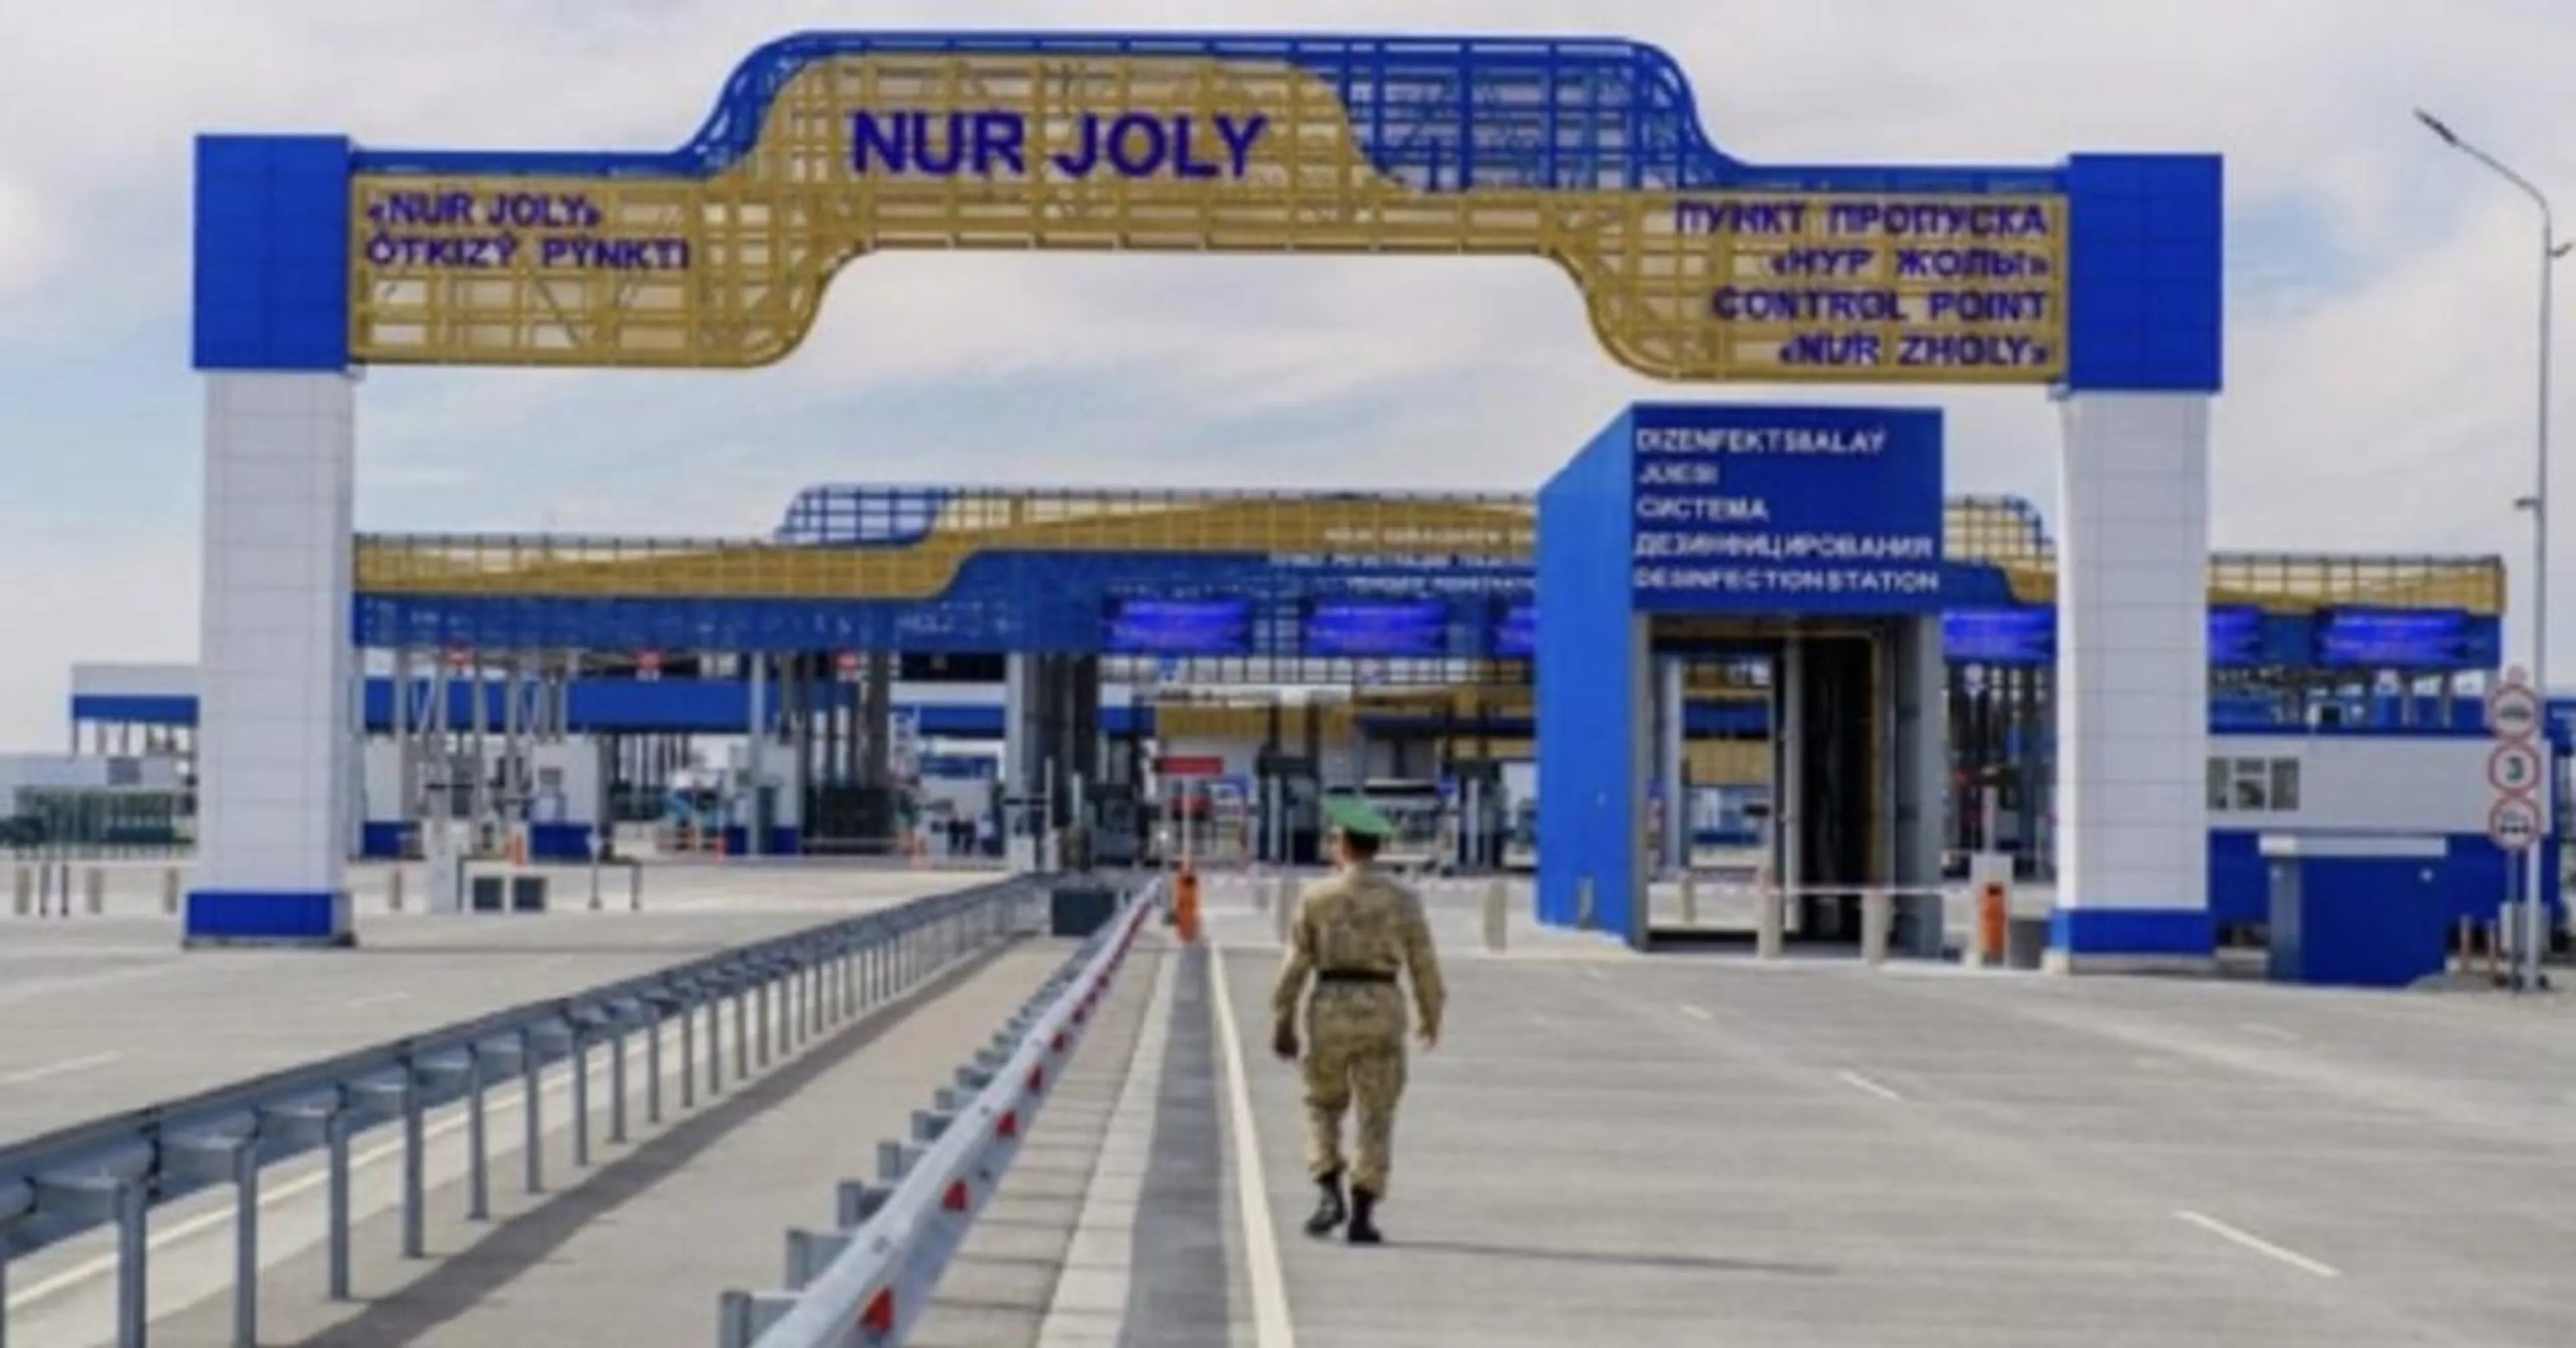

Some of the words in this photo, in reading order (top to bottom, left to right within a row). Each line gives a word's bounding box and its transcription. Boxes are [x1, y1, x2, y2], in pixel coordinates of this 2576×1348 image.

[851, 109, 1025, 177] NUR
[1051, 111, 1269, 179] JOLY
[368, 192, 474, 225] «NUR
[487, 193, 602, 227] JOLY»
[1677, 203, 1805, 235] ПУНКТ
[1829, 204, 2047, 236] ПРОПУСКА
[1712, 287, 1908, 321] CONTROL
[1929, 289, 2045, 321] POINT
[1779, 334, 1879, 366] «NUR
[1636, 495, 1770, 521] СИСТЕМА
